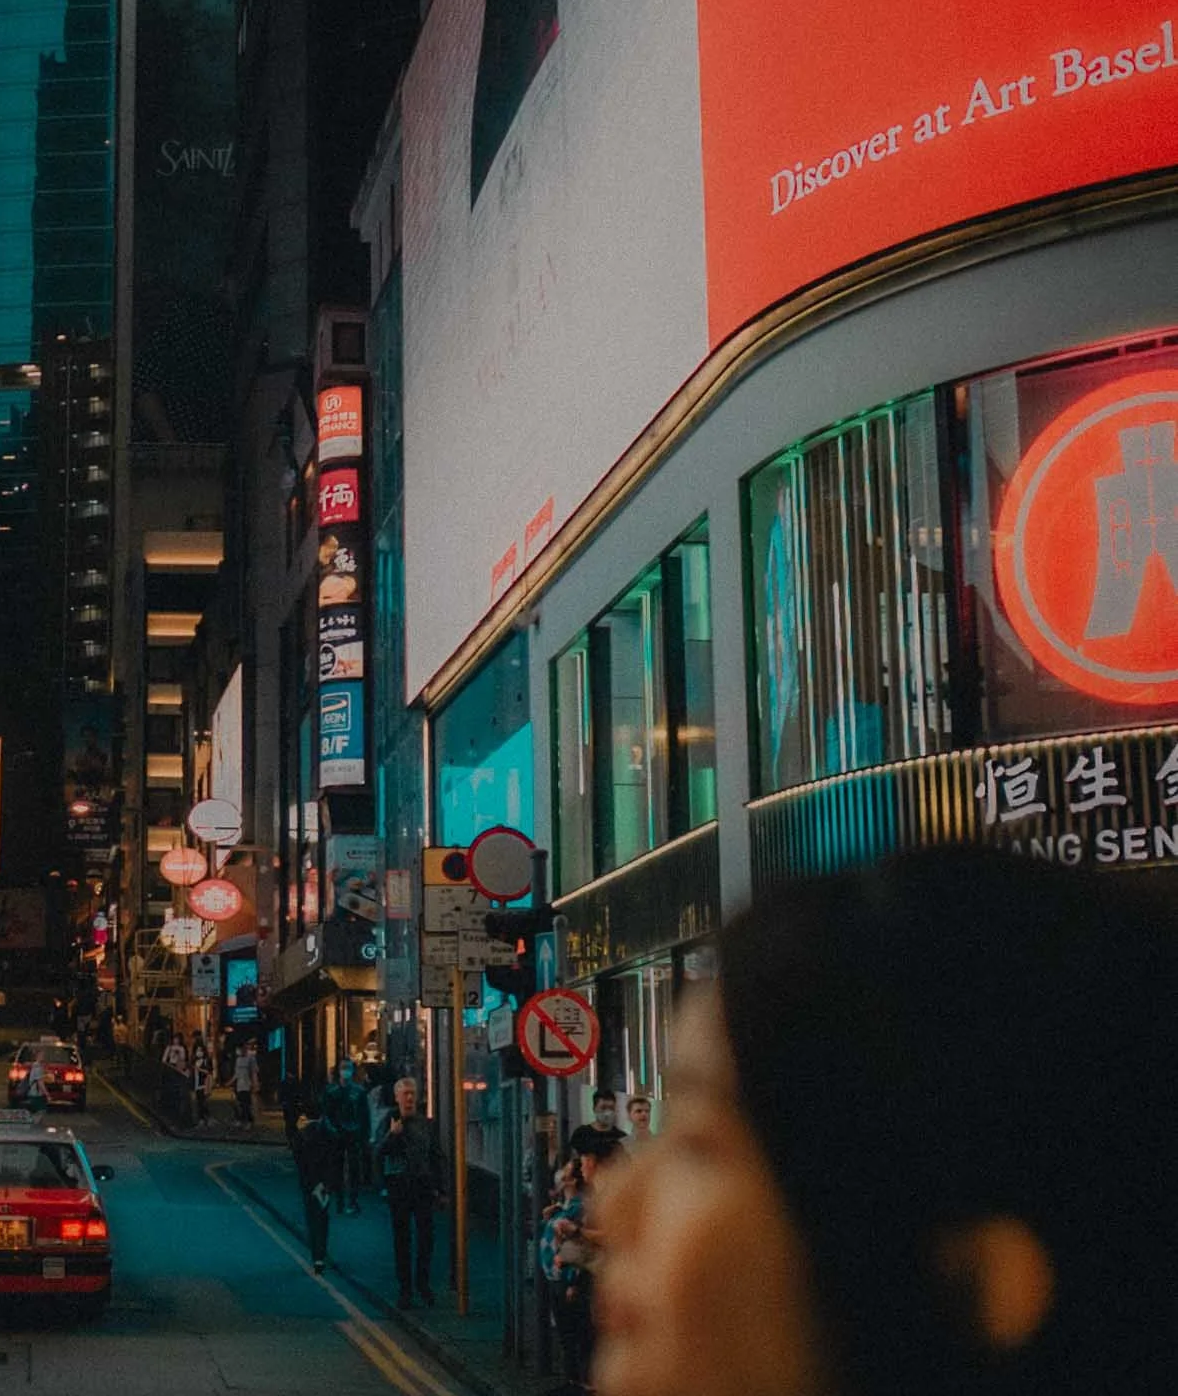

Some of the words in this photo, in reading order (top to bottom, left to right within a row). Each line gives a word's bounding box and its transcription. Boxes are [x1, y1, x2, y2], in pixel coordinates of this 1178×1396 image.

[770, 124, 903, 216] Discover
[913, 102, 952, 144] at
[961, 77, 1036, 126] Art
[1050, 21, 1178, 98] Basel
[1005, 833, 1083, 866] ANG
